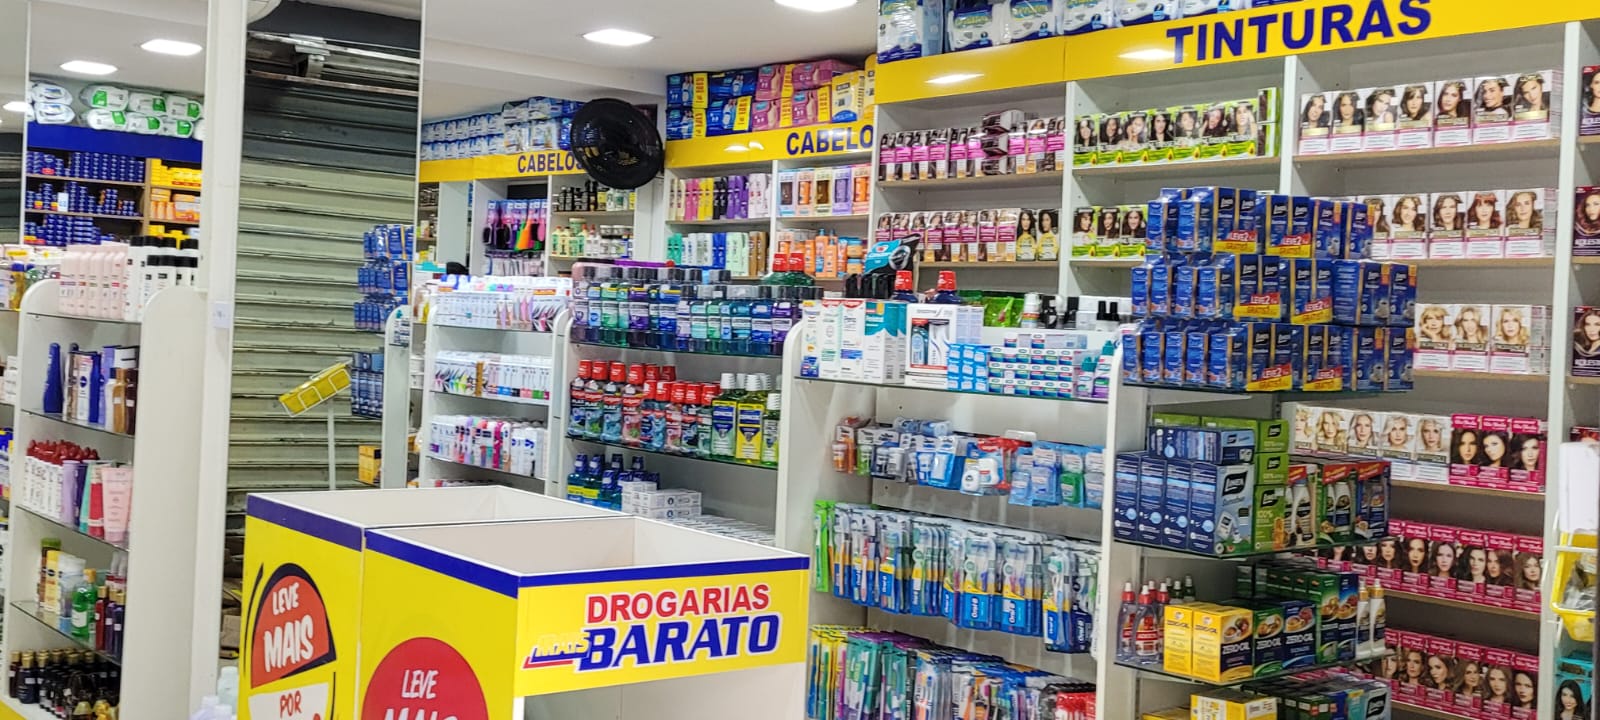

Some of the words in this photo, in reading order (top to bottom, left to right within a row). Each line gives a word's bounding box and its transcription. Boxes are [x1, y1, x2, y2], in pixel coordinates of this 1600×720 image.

[1166, 0, 1431, 64] TINTURAS
[272, 582, 299, 616] LEVE
[587, 584, 769, 623] DROGARIAS
[264, 614, 314, 672] MAIS
[578, 614, 779, 671] BARATO
[401, 669, 439, 700] LEVE
[280, 690, 302, 719] POR
